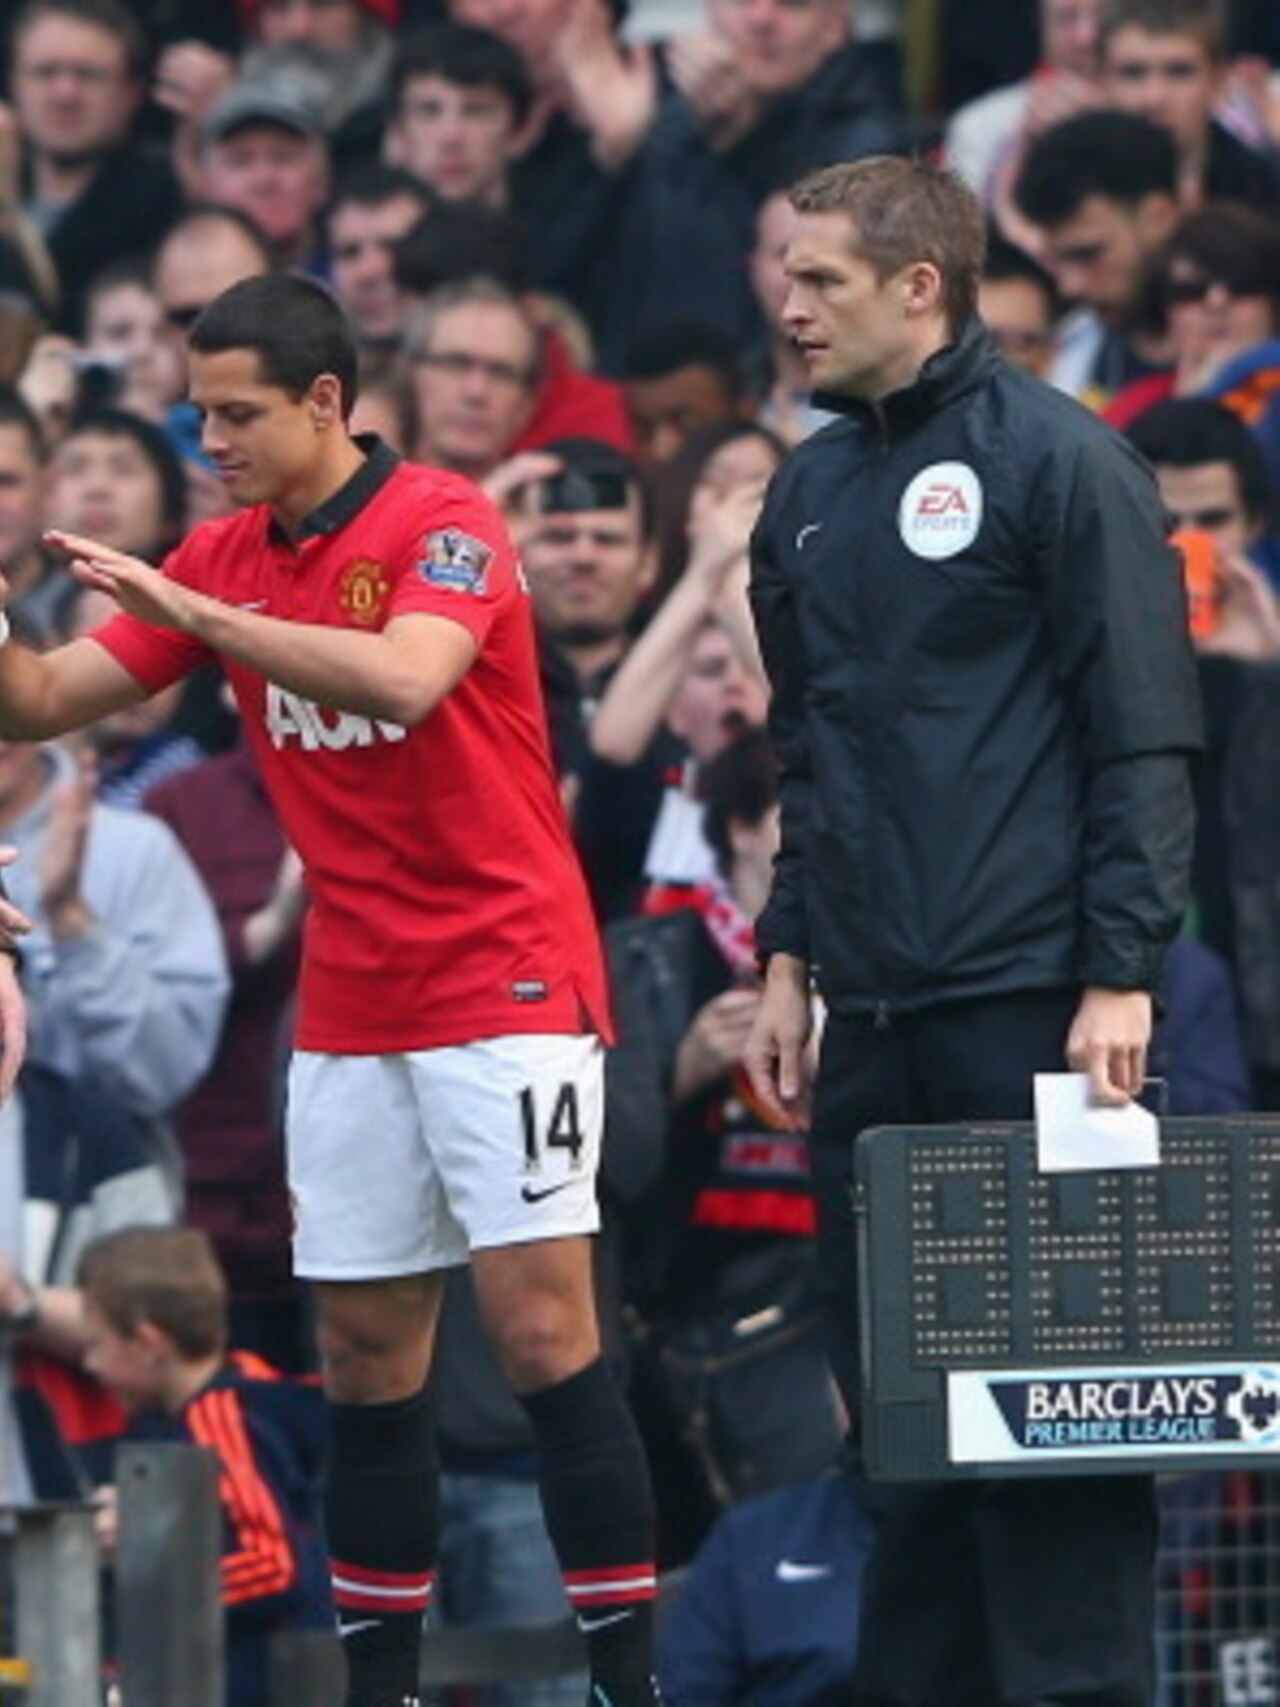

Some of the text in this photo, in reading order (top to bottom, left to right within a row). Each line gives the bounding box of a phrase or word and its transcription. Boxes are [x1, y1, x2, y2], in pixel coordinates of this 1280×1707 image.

[917, 483, 969, 514] EA
[517, 1081, 584, 1170] 14
[1025, 1378, 1217, 1420] BARCLAYS
[1024, 1417, 1215, 1445] PREMIER LEAGUE
